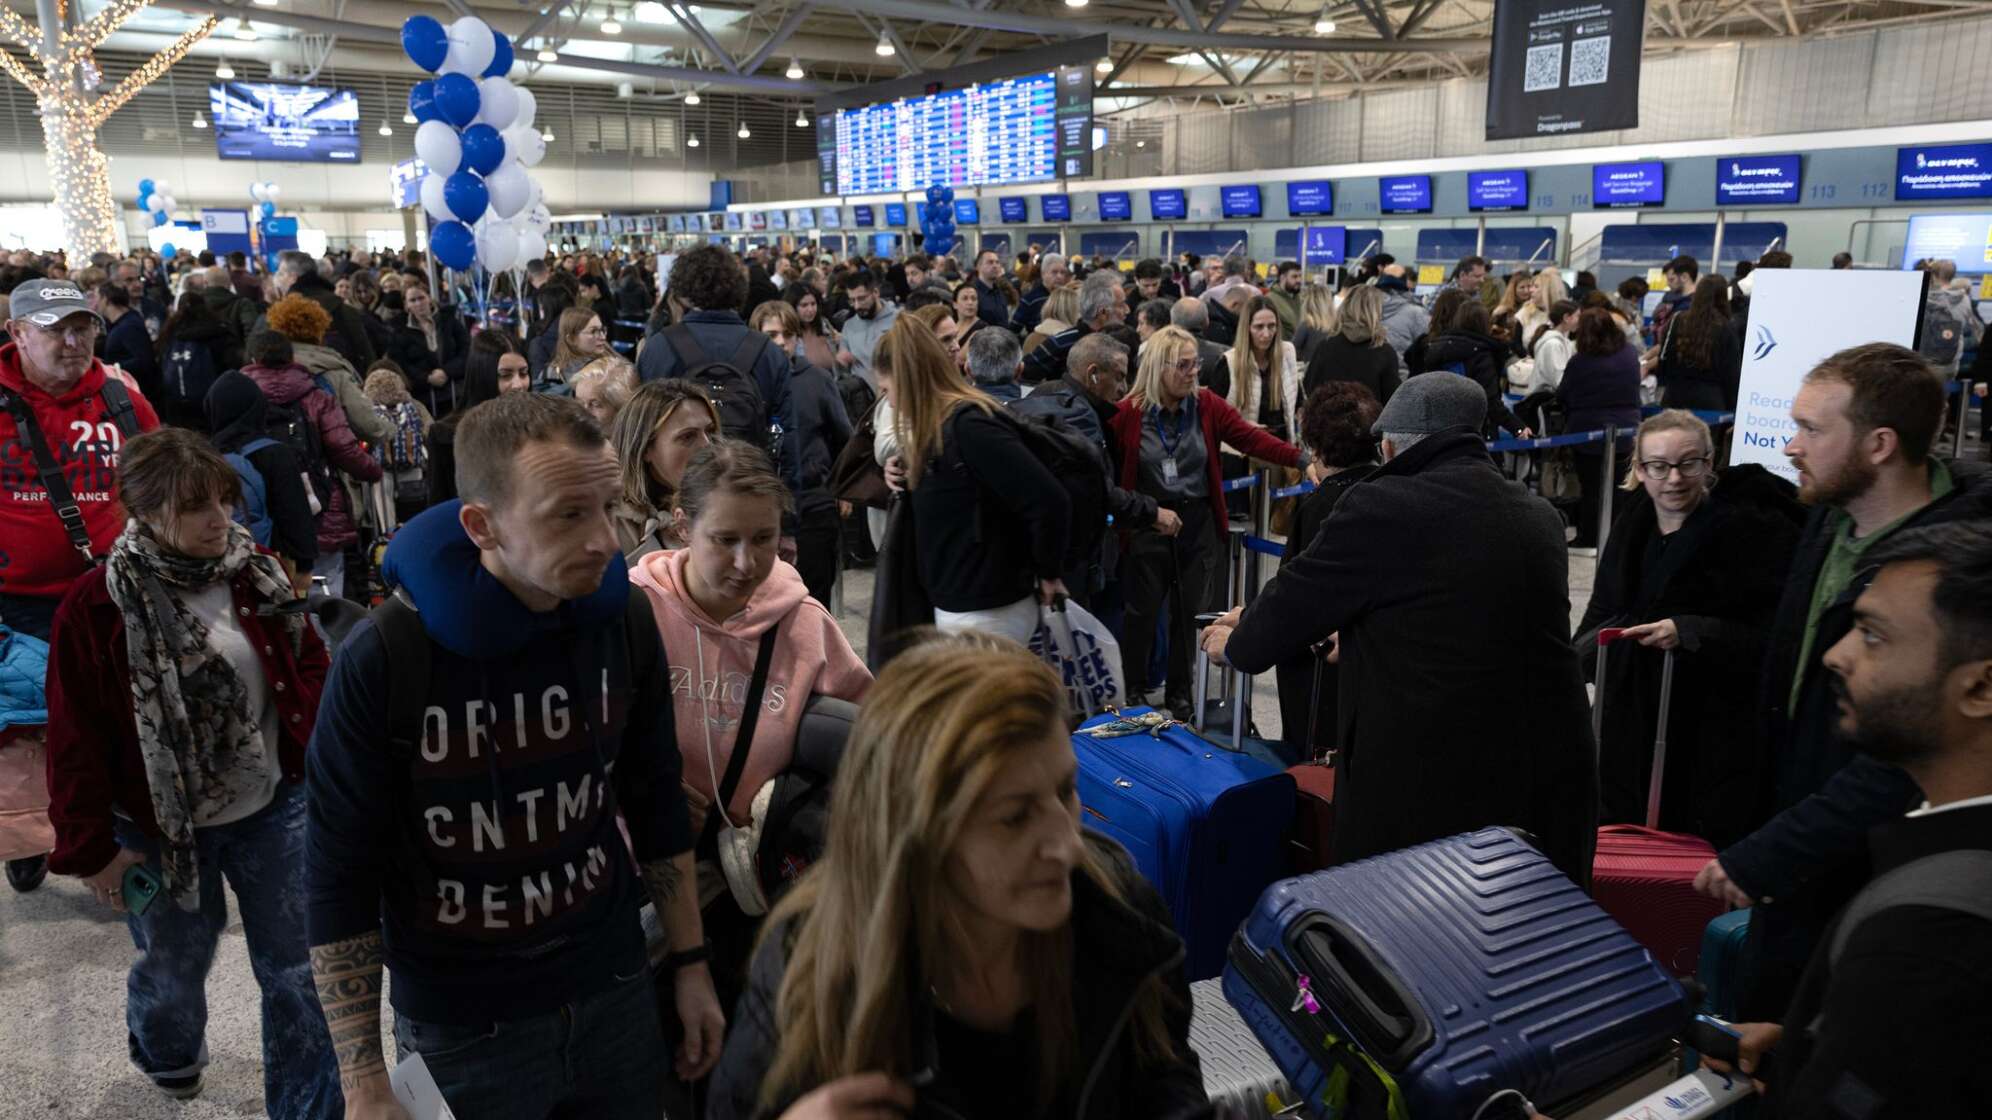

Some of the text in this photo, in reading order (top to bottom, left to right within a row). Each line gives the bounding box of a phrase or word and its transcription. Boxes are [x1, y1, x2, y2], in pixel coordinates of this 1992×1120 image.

[1811, 185, 1836, 198] 113
[1862, 183, 1888, 198] 112
[204, 215, 216, 229] B
[267, 221, 279, 232] C
[71, 420, 120, 452] 20
[1744, 432, 1776, 449] Not
[13, 491, 110, 502] PERFANCE
[668, 665, 787, 713] Adids
